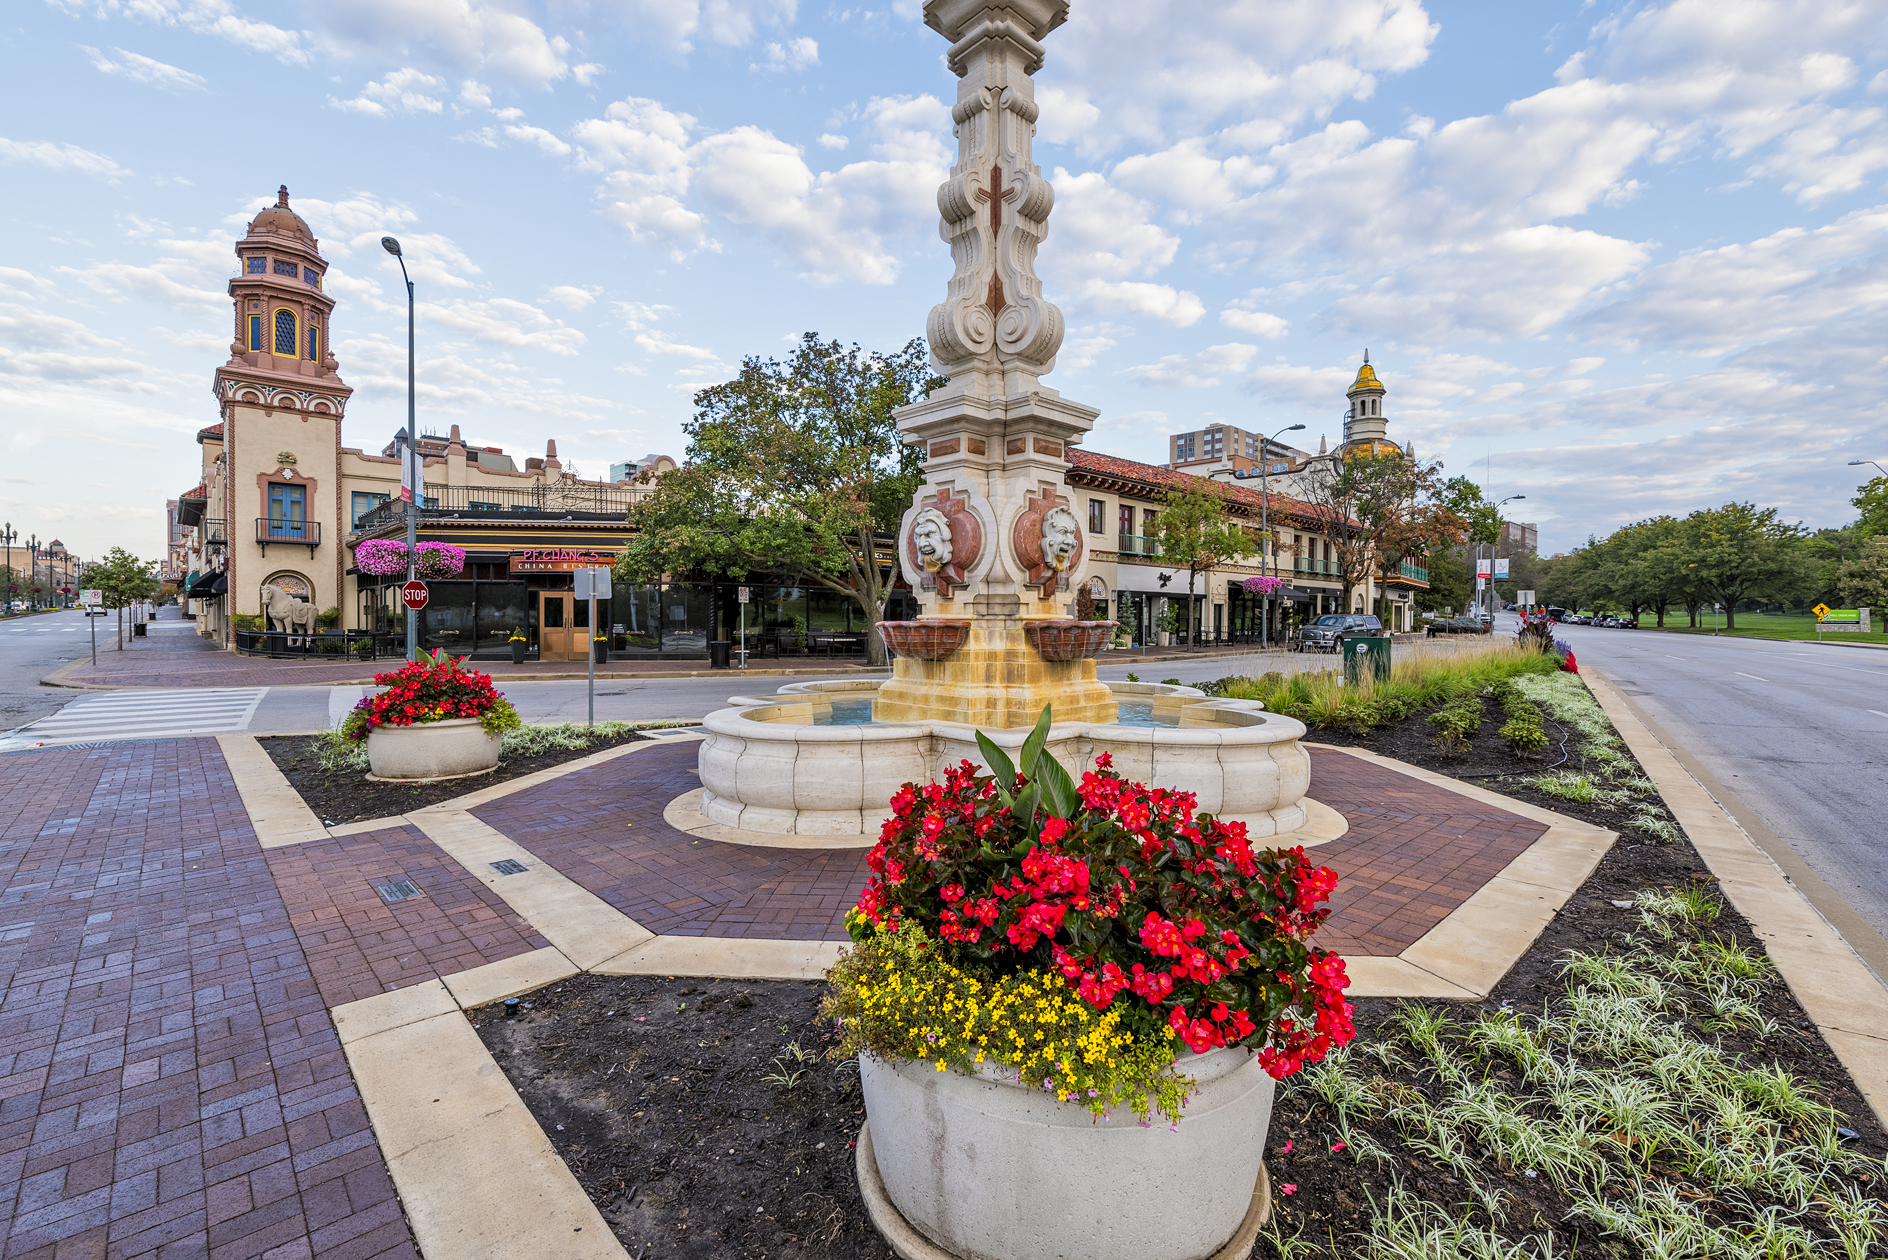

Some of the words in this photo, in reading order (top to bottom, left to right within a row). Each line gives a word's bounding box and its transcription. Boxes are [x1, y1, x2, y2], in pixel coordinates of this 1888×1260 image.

[523, 549, 540, 561] P.F.
[542, 548, 599, 562] CHANG'S
[404, 589, 427, 601] STOP
